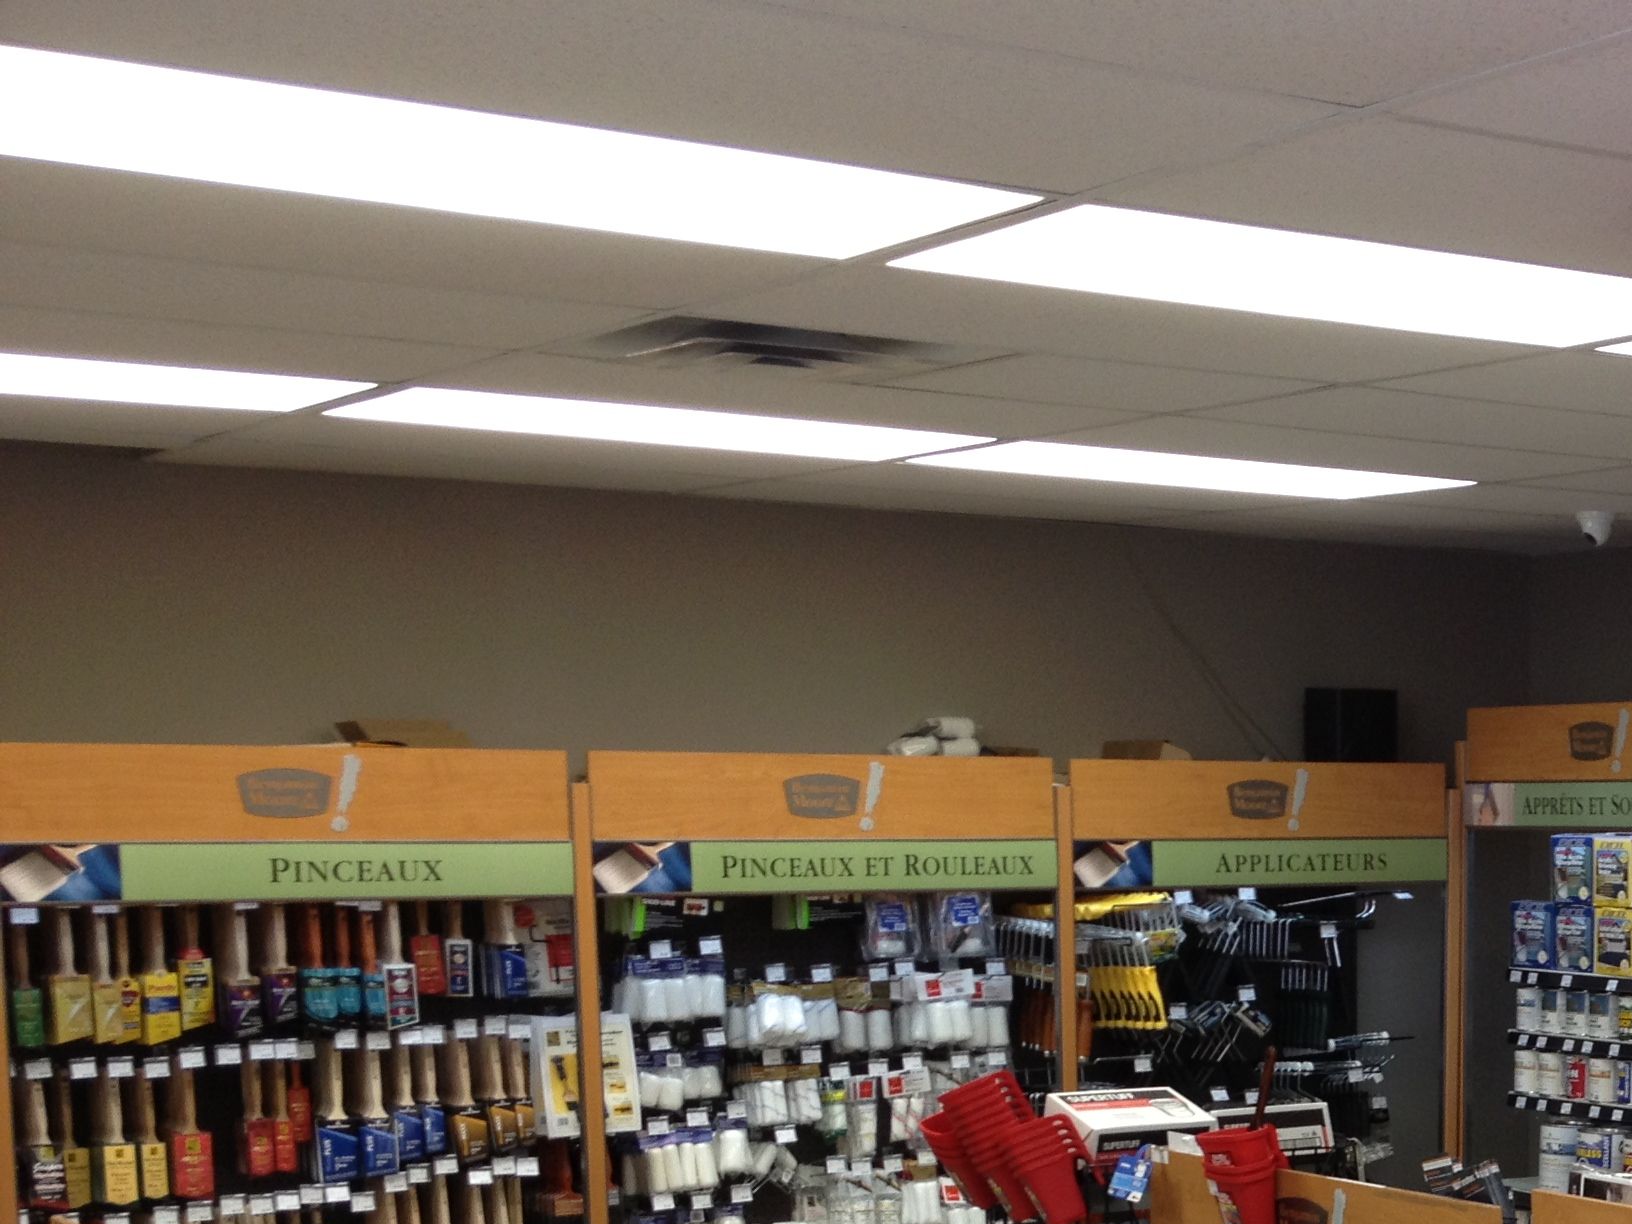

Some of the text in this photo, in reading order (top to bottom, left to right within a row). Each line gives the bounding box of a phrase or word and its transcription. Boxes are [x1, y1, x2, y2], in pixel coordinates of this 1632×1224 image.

[1589, 796, 1604, 815] ET
[269, 856, 443, 883] PINCEAUX
[721, 852, 1034, 880] PINCEAUX ET ROULEAUX
[1215, 851, 1388, 874] APPLICATEURS
